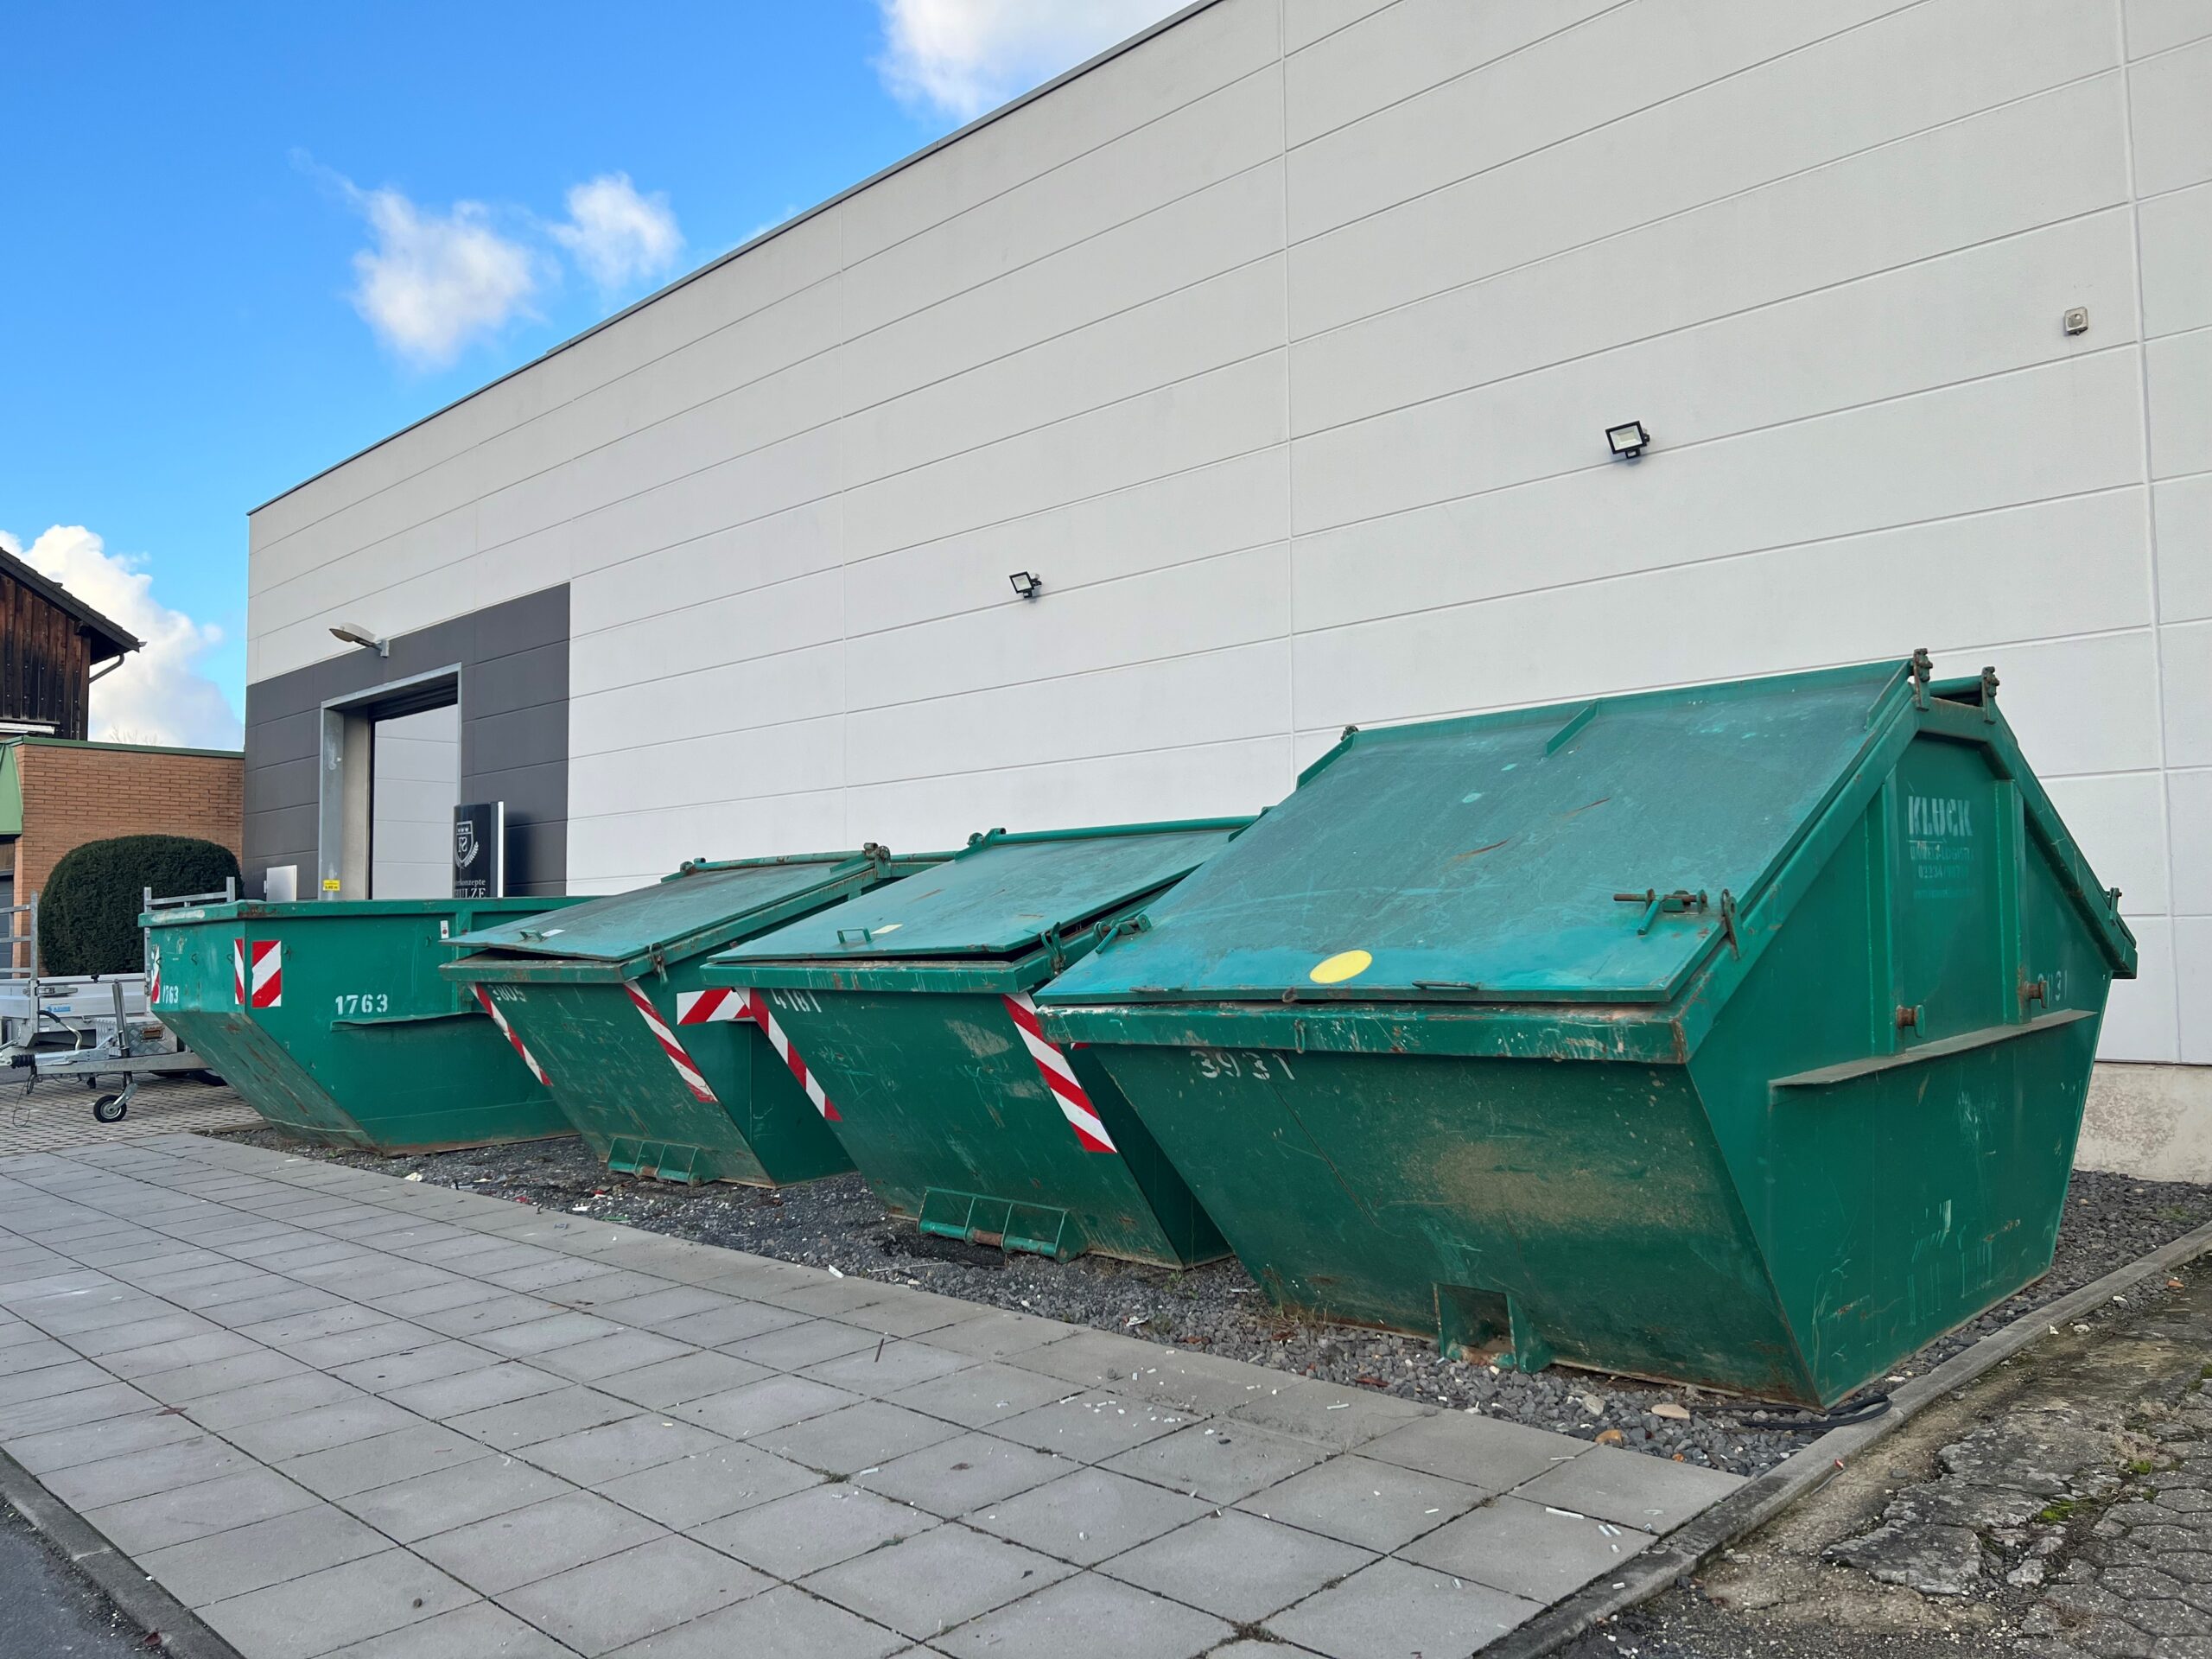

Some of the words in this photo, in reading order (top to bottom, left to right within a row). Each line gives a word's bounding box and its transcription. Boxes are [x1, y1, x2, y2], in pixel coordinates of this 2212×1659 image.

[1908, 795, 1973, 836] KLUCK
[162, 984, 179, 1003] 1763
[335, 994, 388, 1015] 1763
[770, 988, 823, 1013] 4181
[1190, 1050, 1295, 1080] 3931
